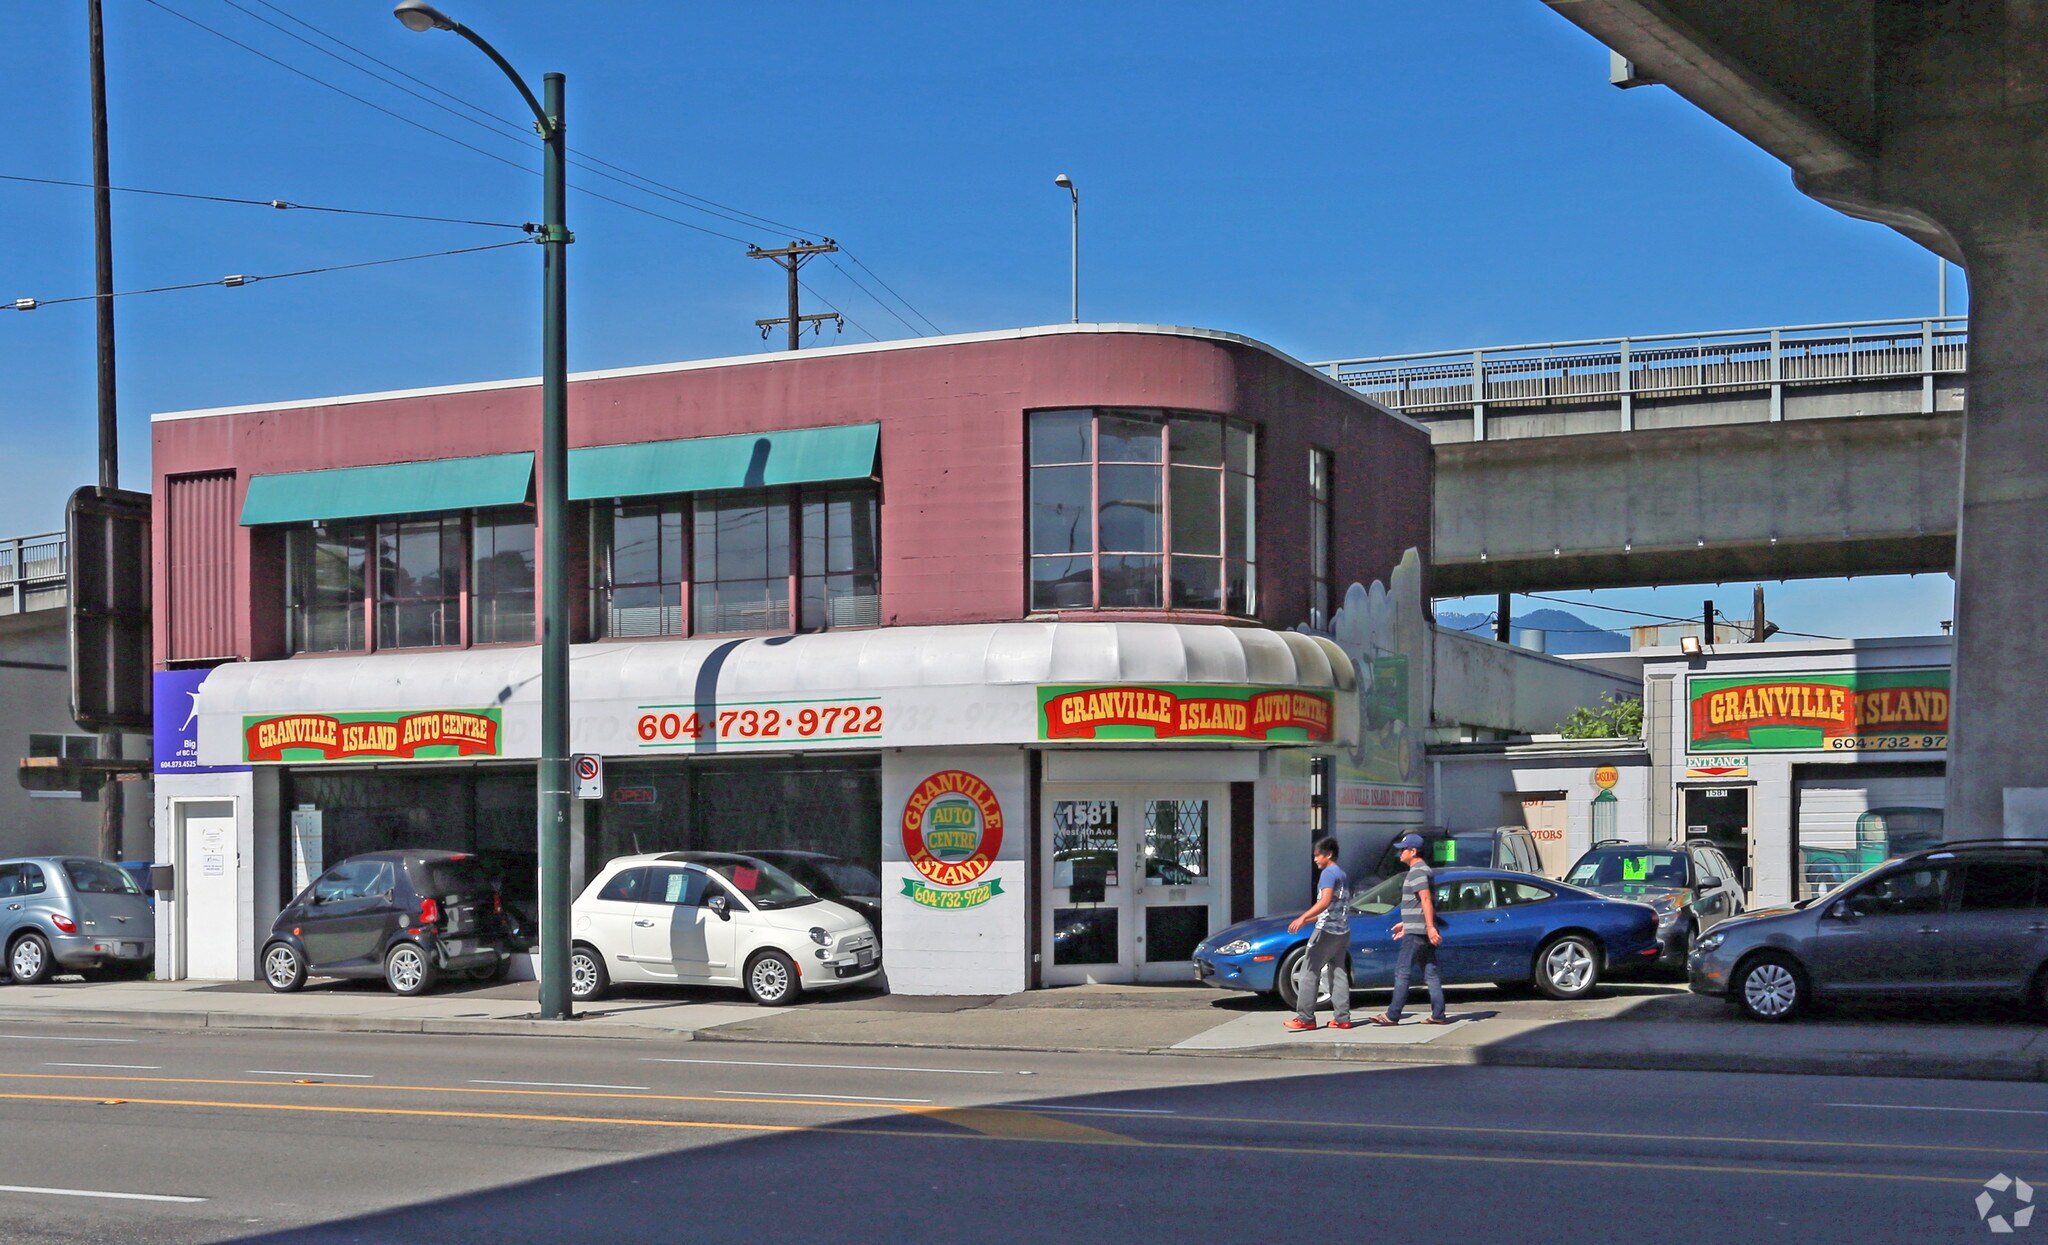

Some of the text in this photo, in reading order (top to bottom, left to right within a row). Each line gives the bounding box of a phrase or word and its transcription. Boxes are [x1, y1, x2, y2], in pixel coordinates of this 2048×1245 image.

[1061, 692, 1328, 731] GRANVILLE ISLAND AUTO CENTRE
[1710, 686, 1948, 727] GRANVILLE ISLAND
[258, 717, 337, 749] GRANVILLE
[342, 726, 398, 752] ISLAND
[402, 714, 440, 745] AUTO
[442, 713, 488, 740] CENTRE
[184, 739, 196, 749] Big
[1687, 756, 1747, 767] ENTRANCE
[905, 773, 1001, 830] GRANVILLE
[931, 807, 973, 824] AUTO
[1063, 804, 1112, 825] 1581
[929, 831, 976, 849] CENTRE
[1096, 827, 1115, 836] Ave.
[1530, 830, 1563, 840] OTORS
[911, 847, 989, 885] ISLAND
